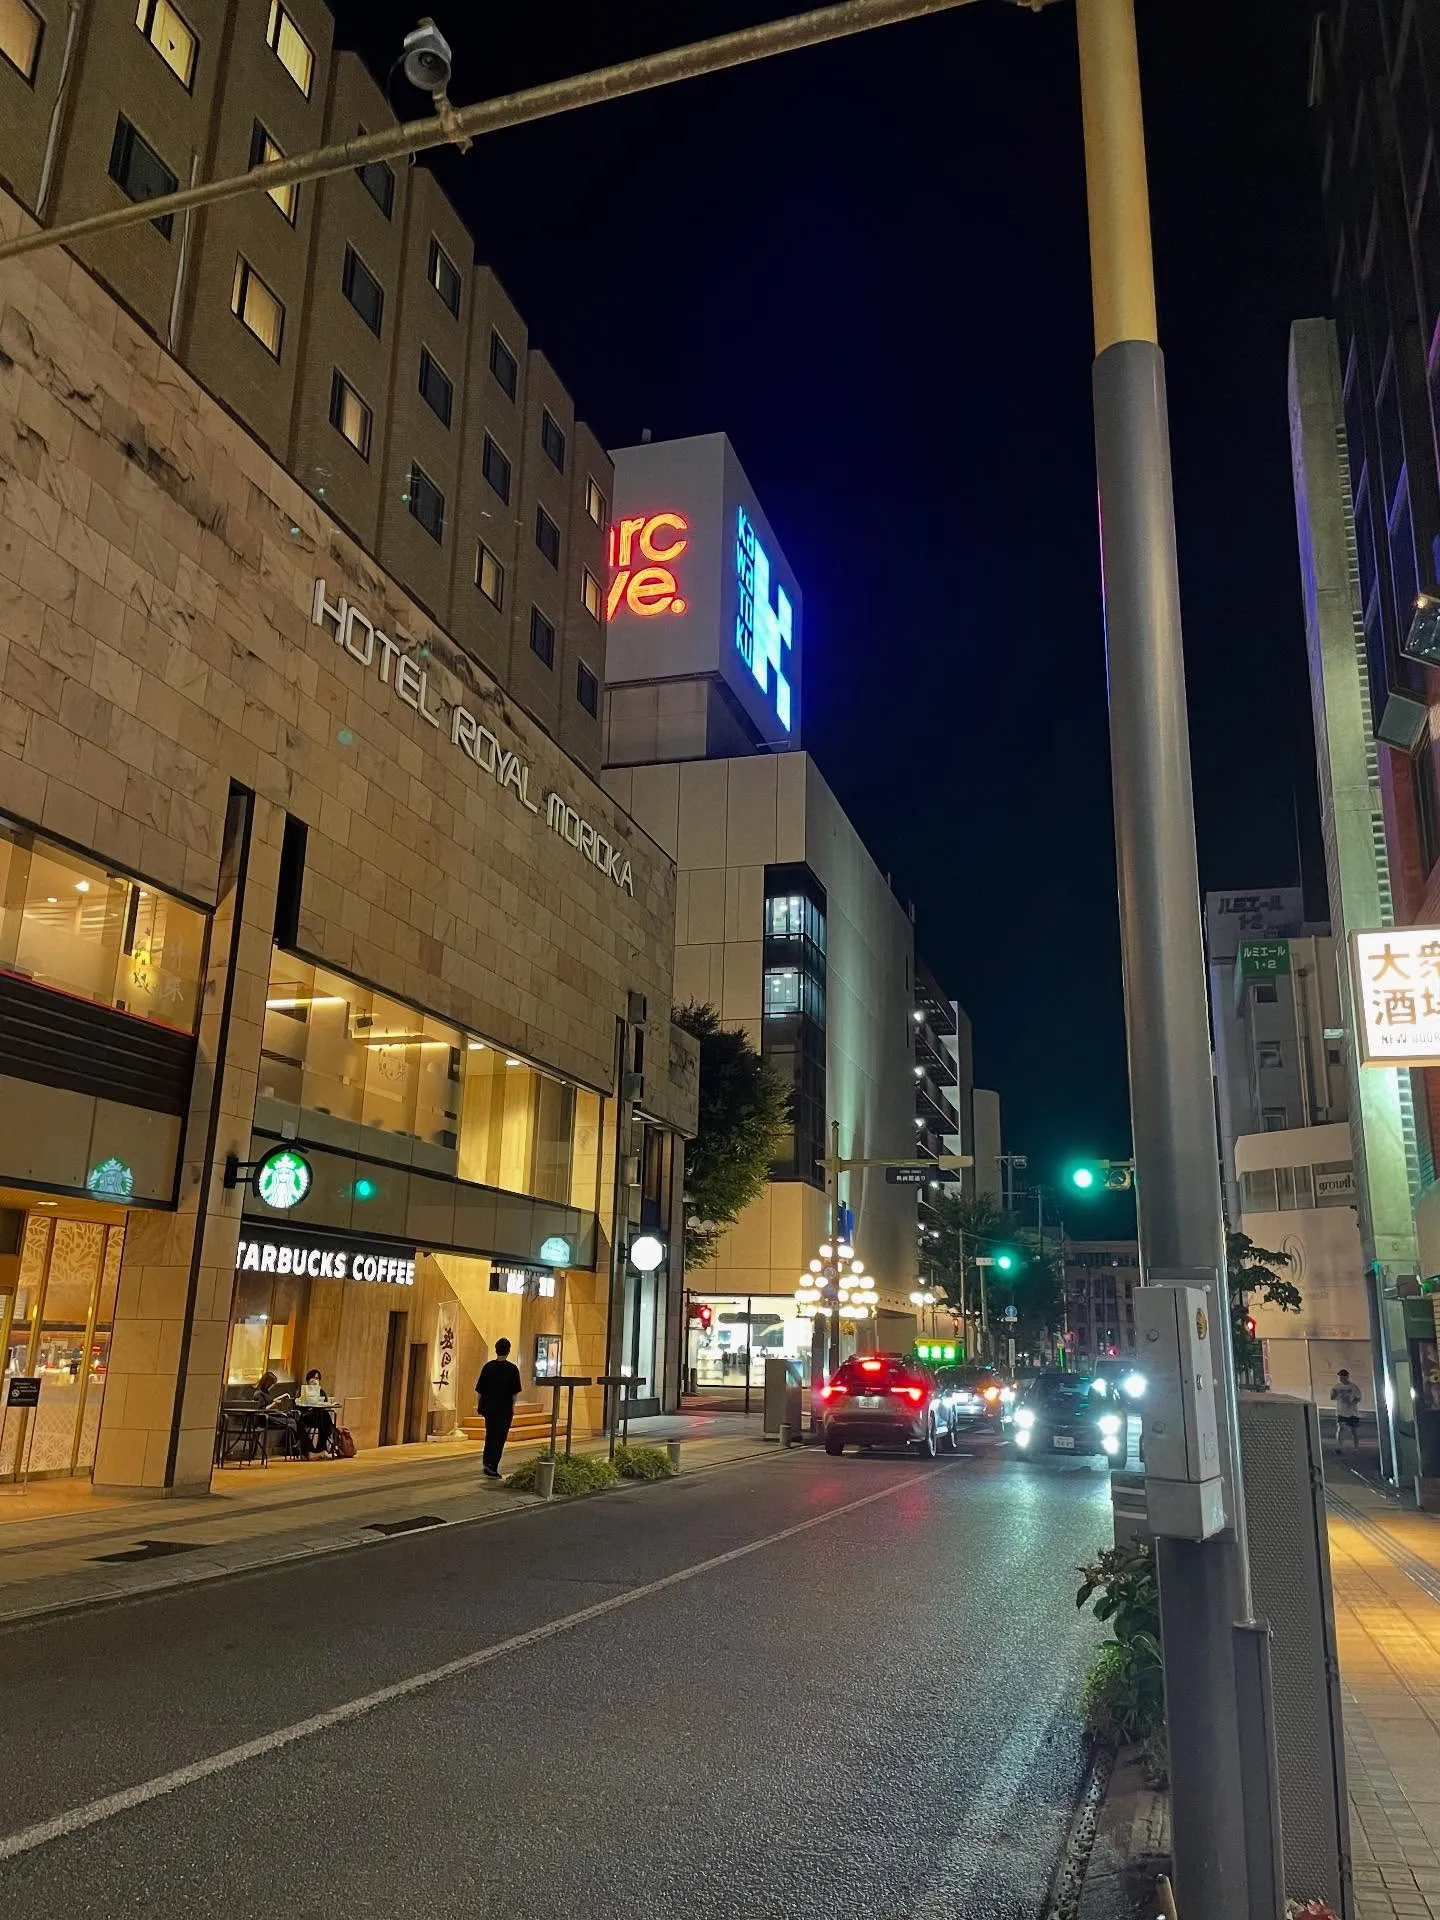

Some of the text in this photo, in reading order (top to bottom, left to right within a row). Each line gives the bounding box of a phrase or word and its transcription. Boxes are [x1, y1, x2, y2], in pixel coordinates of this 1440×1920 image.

[312, 577, 633, 897] HOTEL ROYAL MORIOKA
[1243, 946, 1286, 958] ルミエール
[352, 1254, 416, 1286] COFFEE
